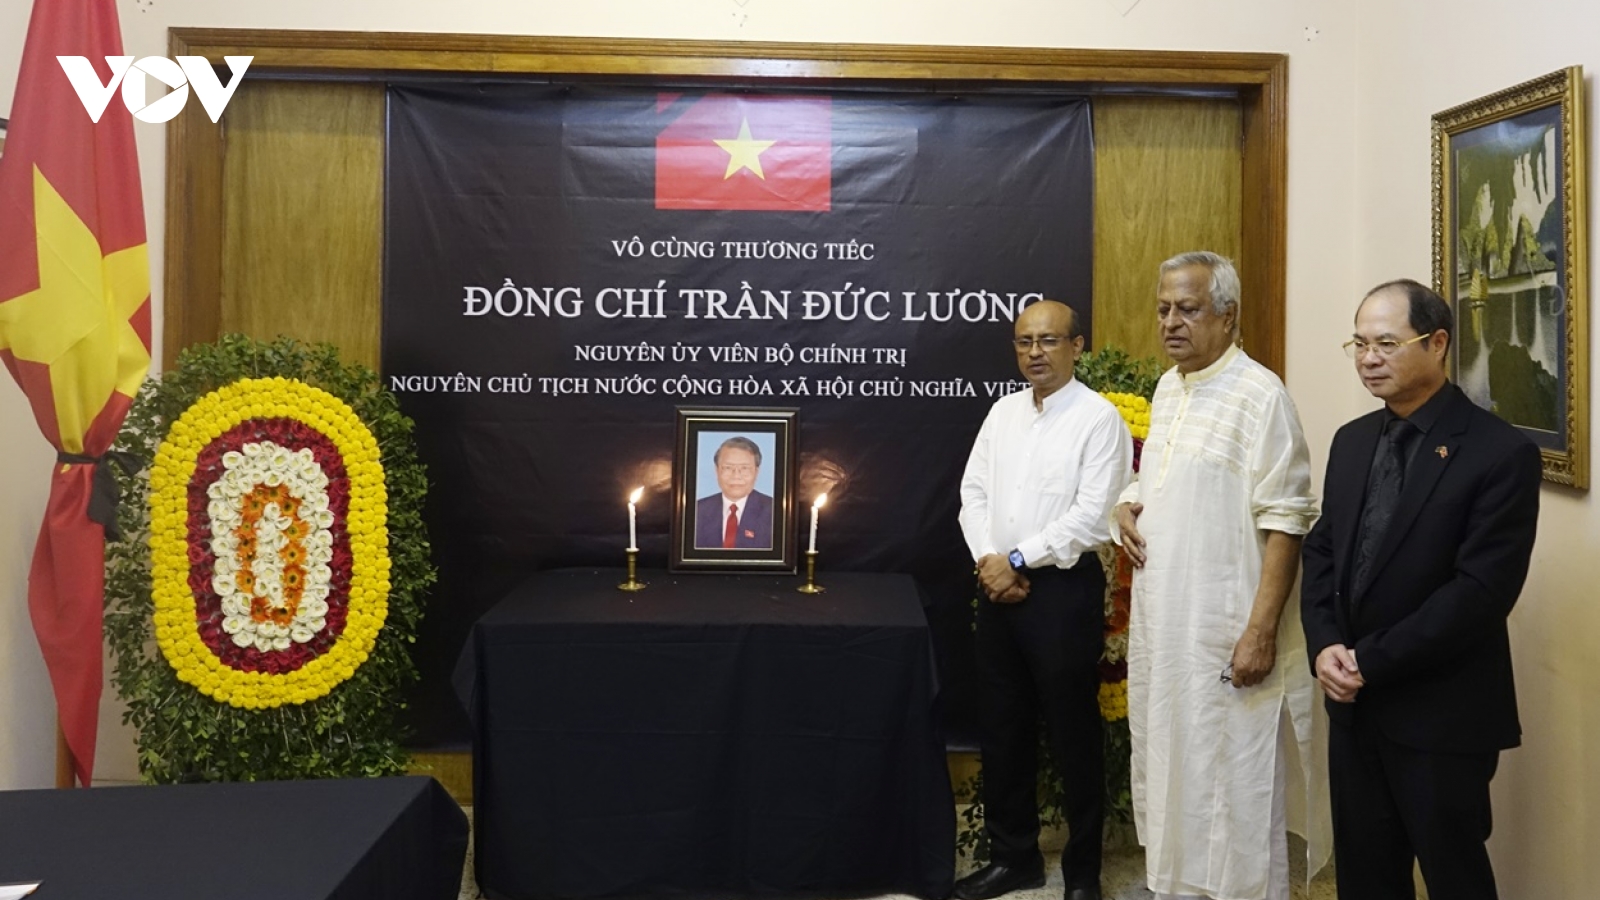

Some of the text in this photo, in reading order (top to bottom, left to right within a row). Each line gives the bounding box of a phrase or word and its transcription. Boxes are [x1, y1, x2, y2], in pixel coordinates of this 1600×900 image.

[611, 236, 875, 260] VÔ CÙNG THƯƠNG TIẾC
[463, 278, 584, 317] ĐỒNG
[595, 280, 667, 318] CHÍ
[679, 281, 791, 319] TRẦN
[802, 282, 890, 321] ĐỨC
[575, 342, 907, 367] NGUYÊN ỦY VIÊN BỘ CHÍNH TRỊ
[391, 372, 481, 392] NGUYÊN
[488, 373, 532, 393] CHỦ
[539, 378, 588, 397] TỊCH
[595, 374, 656, 394] NƯỚC
[663, 375, 722, 397] CỘNG
[729, 375, 773, 395] HÒA
[780, 376, 810, 395] XÃ
[817, 376, 853, 398] HỘI
[860, 377, 903, 396] CHỦ
[910, 378, 977, 397] NGHĨA
